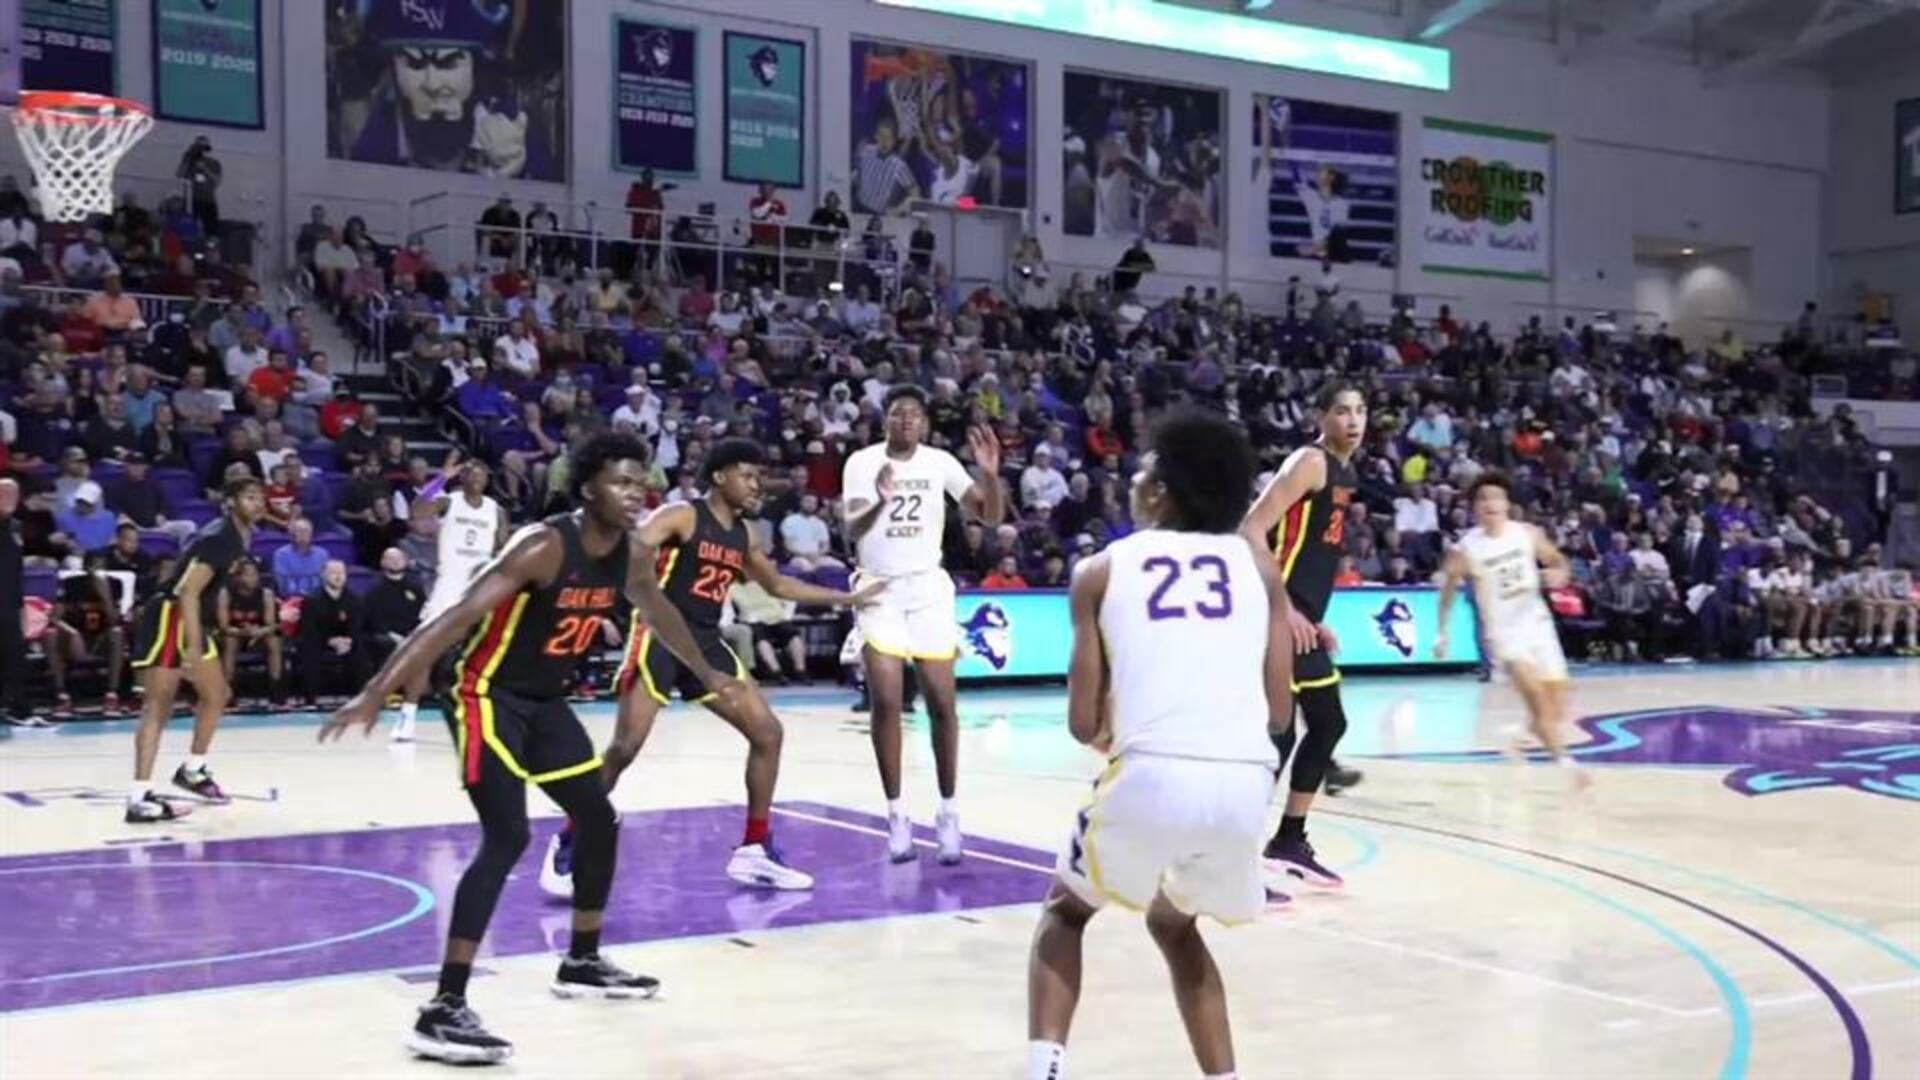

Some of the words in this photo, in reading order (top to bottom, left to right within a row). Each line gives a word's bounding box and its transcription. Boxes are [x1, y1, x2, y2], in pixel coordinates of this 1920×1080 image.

[1420, 158, 1545, 196] CROWTHER
[1431, 189, 1533, 223] ROOFING
[890, 495, 922, 522] 22
[698, 541, 724, 562] OAK
[556, 587, 590, 609] OAK
[692, 565, 733, 602] 23
[1142, 555, 1231, 621] 23
[544, 615, 600, 656] 20
